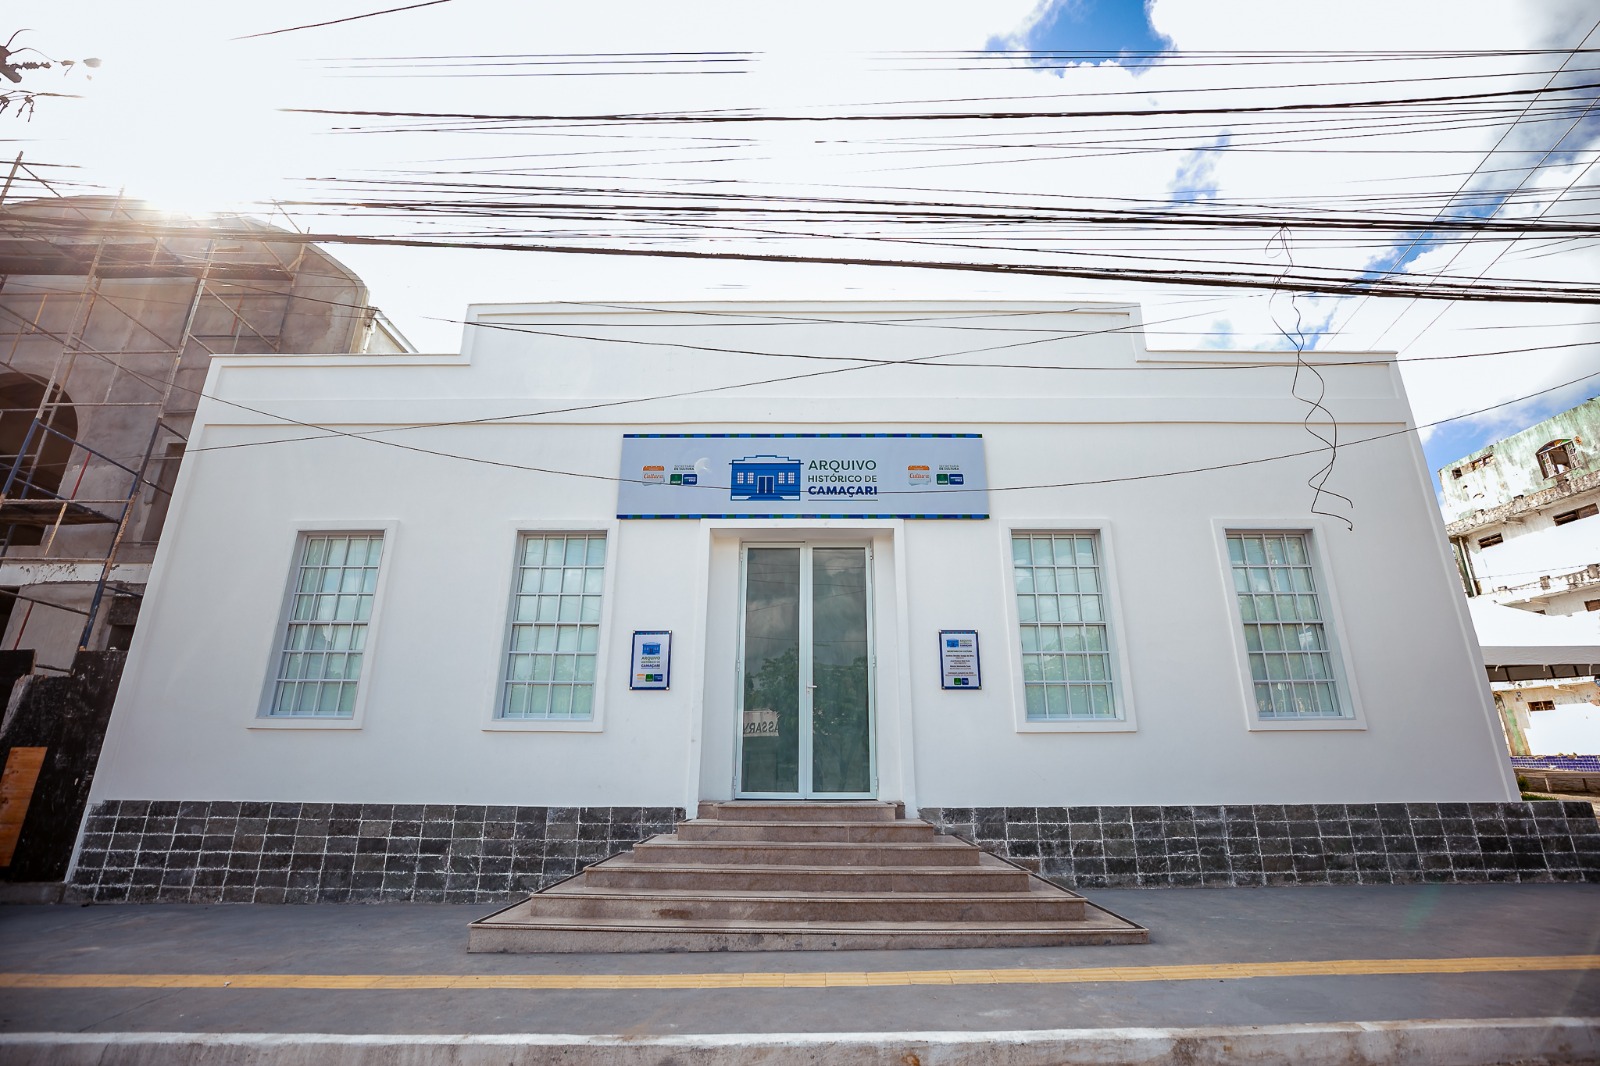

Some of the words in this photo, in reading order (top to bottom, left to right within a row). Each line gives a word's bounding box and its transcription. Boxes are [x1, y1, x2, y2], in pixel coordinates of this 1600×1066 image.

[808, 459, 877, 473] ARQUIVO
[807, 473, 862, 483] HISTÓRICO
[864, 475, 877, 483] DE
[808, 485, 878, 498] CAMAÇARI
